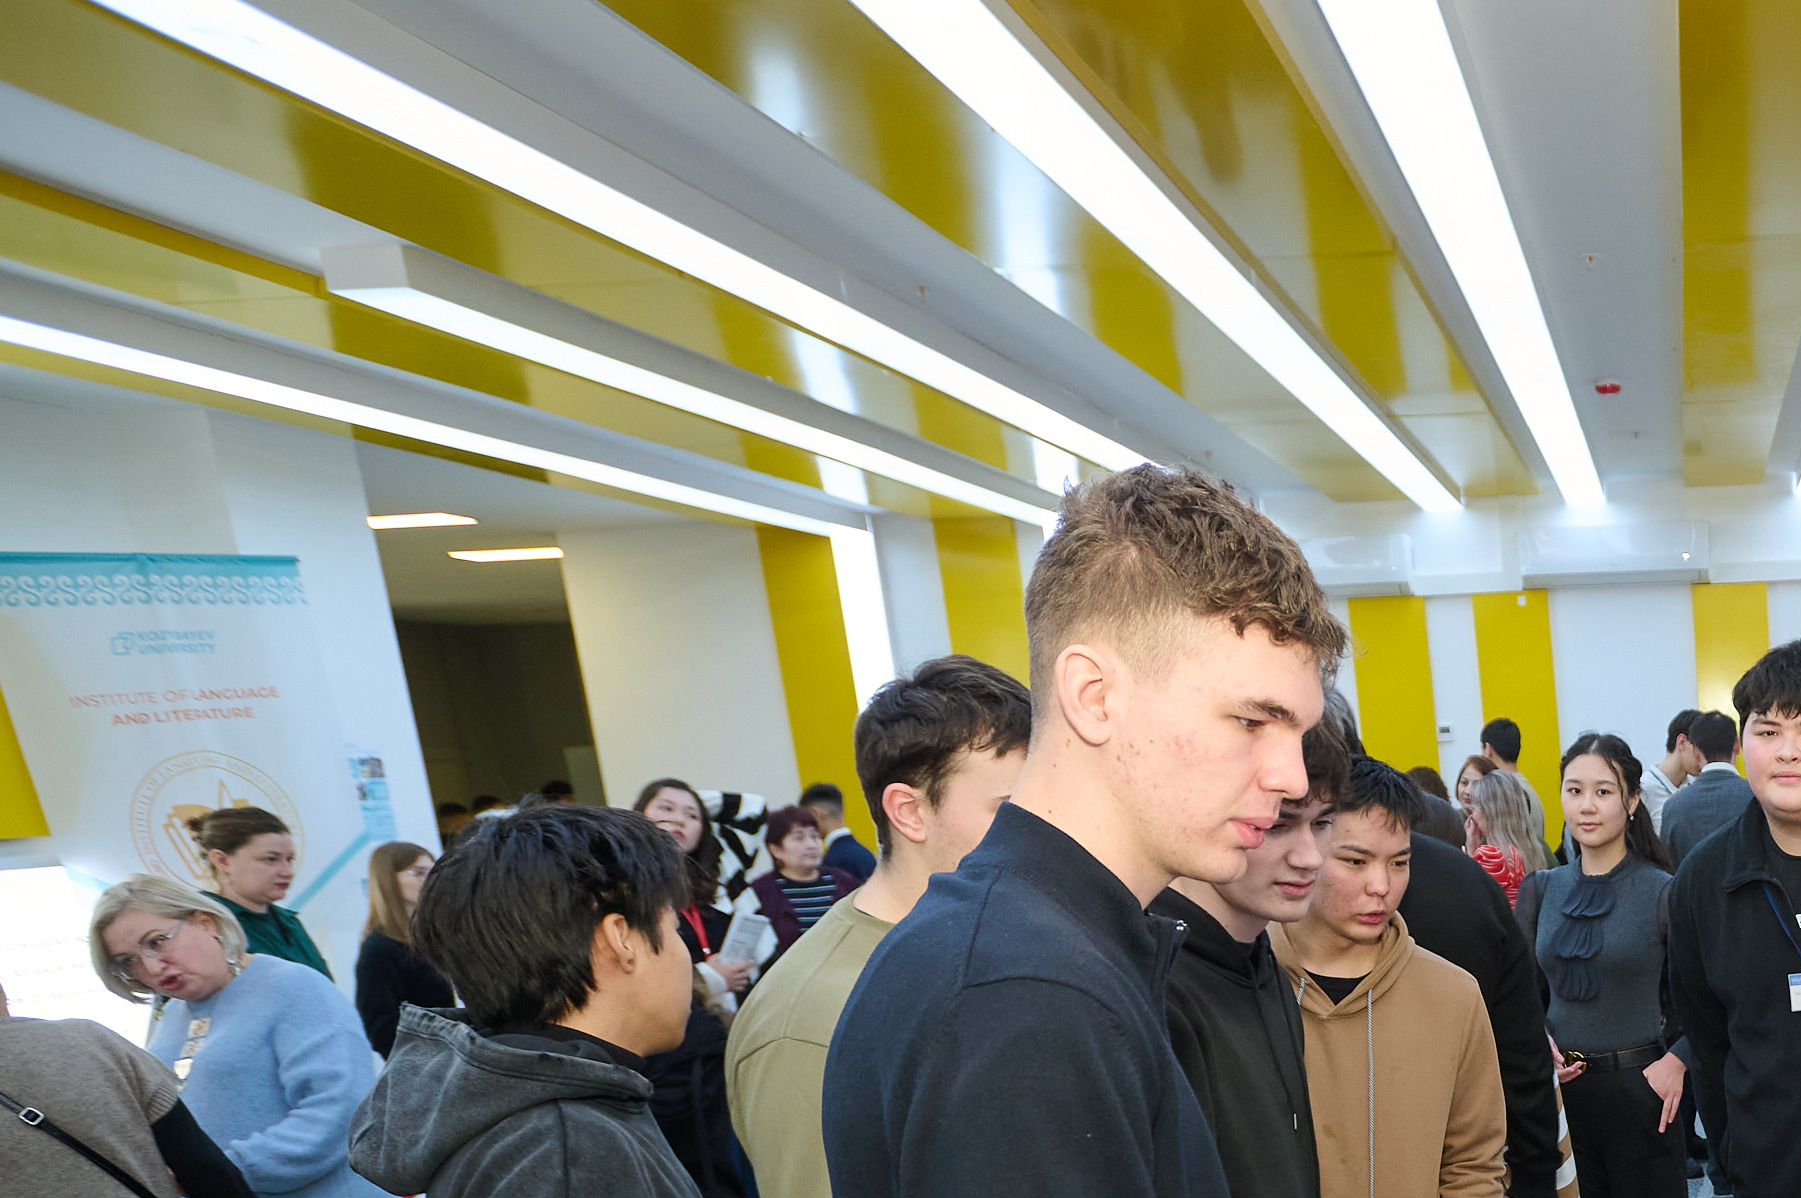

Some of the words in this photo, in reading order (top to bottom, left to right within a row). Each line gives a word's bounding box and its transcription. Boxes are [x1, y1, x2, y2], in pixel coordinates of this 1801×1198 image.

[69, 690, 157, 708] INSTITUTE
[162, 689, 188, 703] OF
[191, 686, 281, 702] LANGUAGE
[111, 711, 150, 727] AND
[152, 706, 256, 724] LITERATURE
